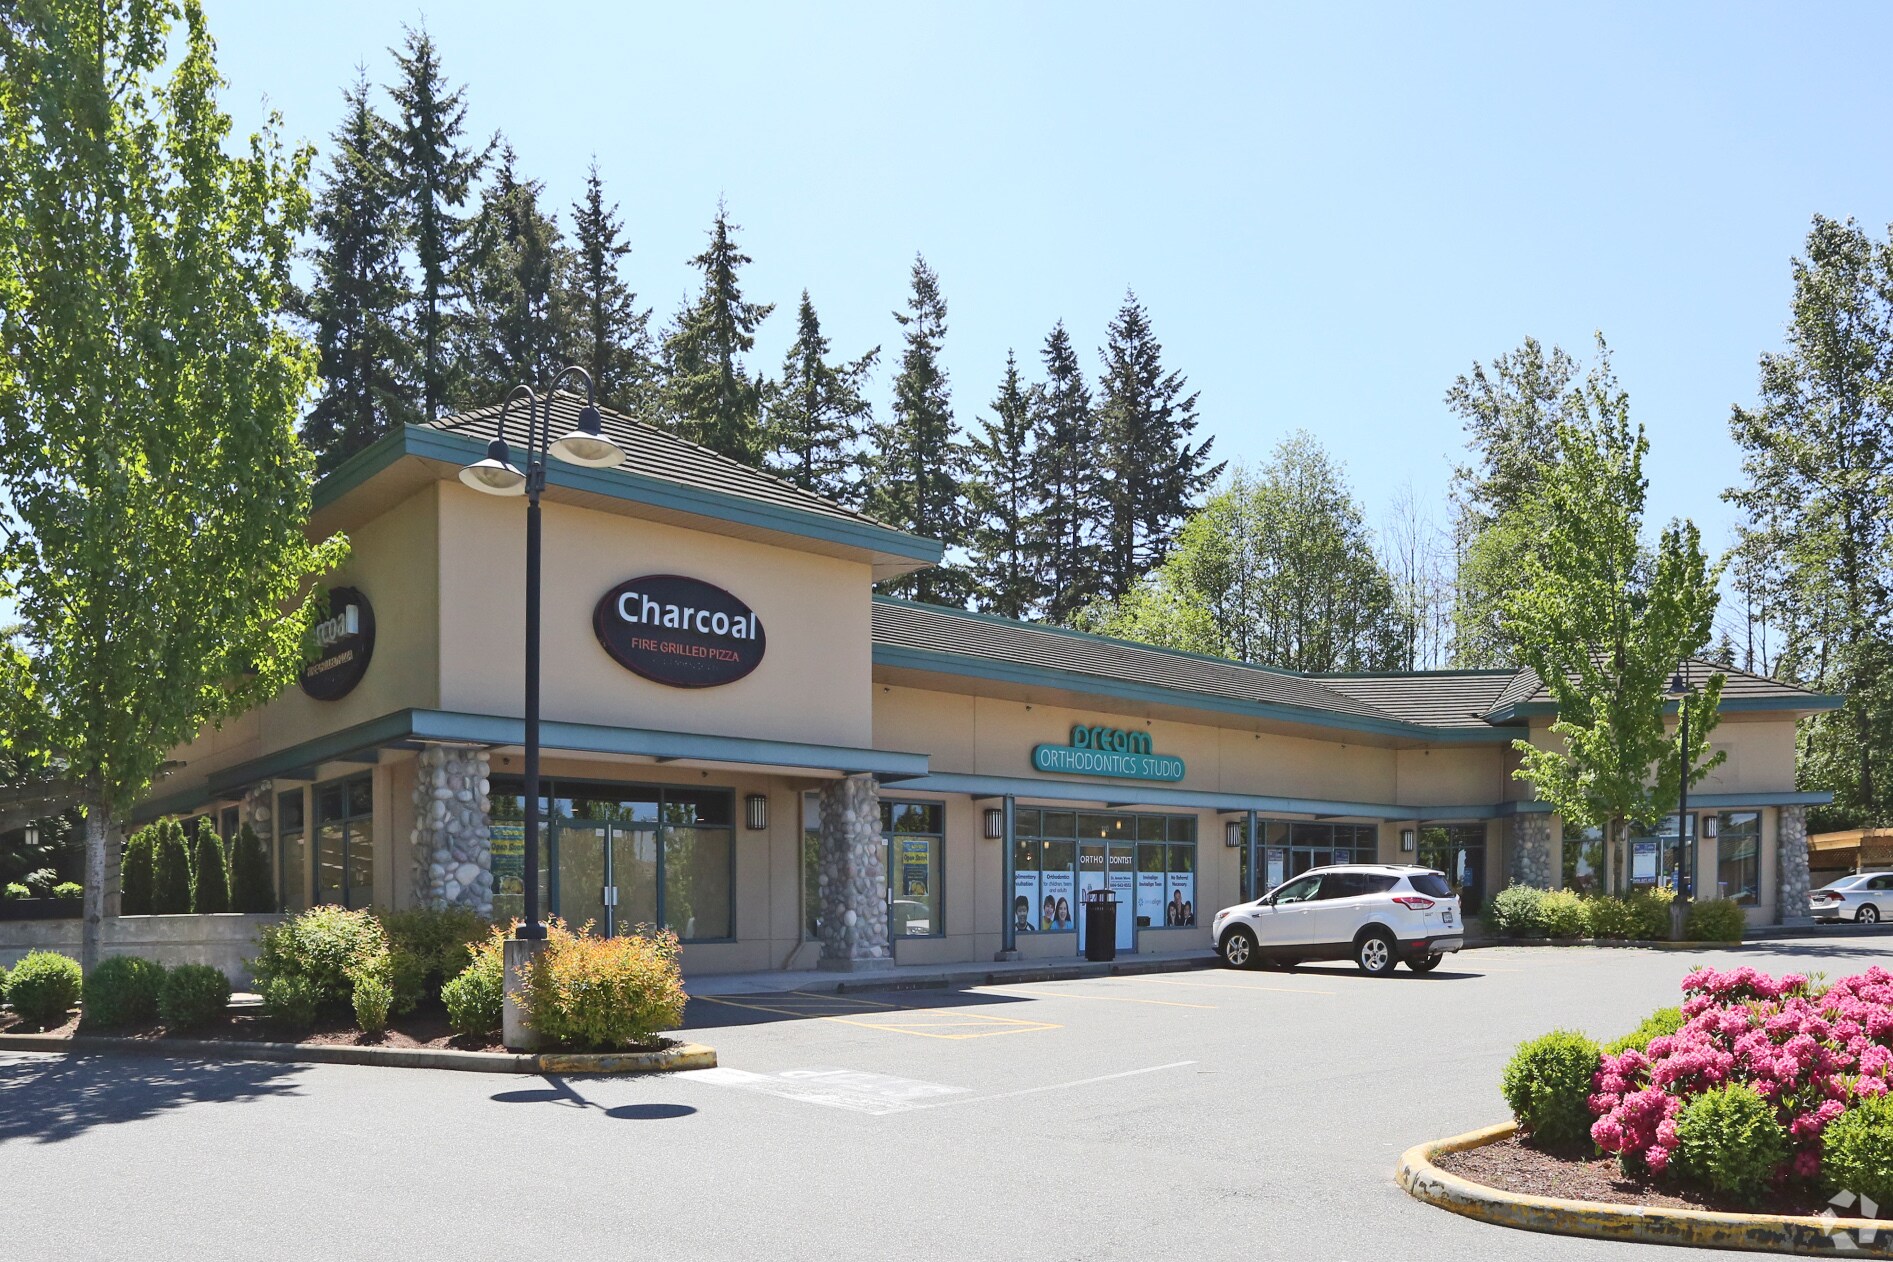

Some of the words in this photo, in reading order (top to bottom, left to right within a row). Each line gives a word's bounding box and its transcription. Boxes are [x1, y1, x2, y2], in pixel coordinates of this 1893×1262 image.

[618, 592, 756, 640] Charcoal
[631, 637, 658, 651] FIRE
[660, 642, 707, 658] GRILLED
[709, 649, 740, 662] PIZZA
[1040, 749, 1137, 774] ORTHODONTICS
[1142, 759, 1182, 778] STUDIO
[1080, 855, 1104, 864] ORTHO
[1110, 856, 1132, 864] DONTIST
